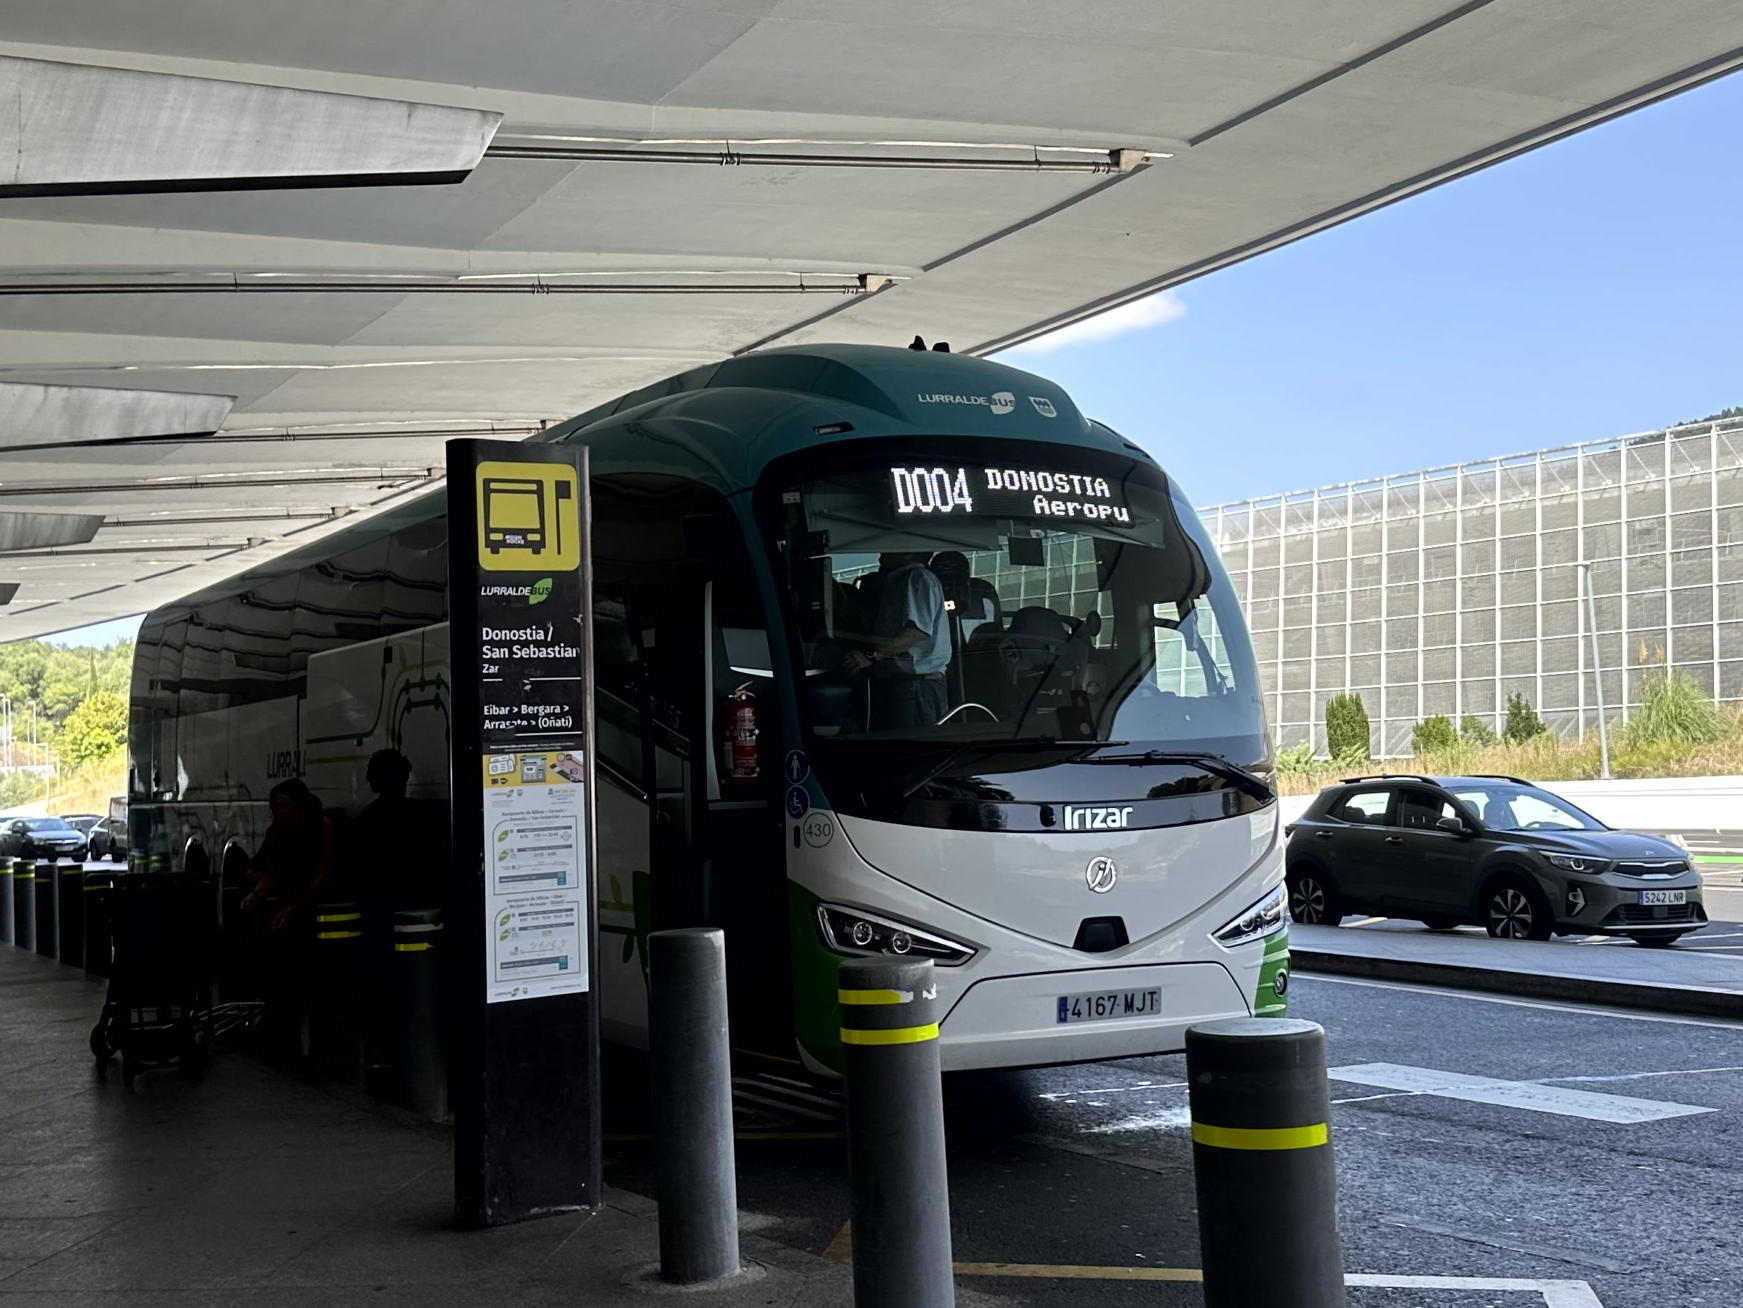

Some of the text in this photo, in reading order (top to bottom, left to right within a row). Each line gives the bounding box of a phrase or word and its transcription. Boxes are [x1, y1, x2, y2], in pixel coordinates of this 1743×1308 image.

[984, 468, 1111, 498] DONOSTIA
[1033, 495, 1130, 522] Aeropu
[482, 625, 544, 641] Donostia
[482, 645, 508, 659] San
[484, 704, 510, 715] Eibar
[521, 704, 561, 717] Bergara
[538, 716, 573, 729] (Oñati)
[1064, 805, 1133, 830] Irizar
[806, 824, 831, 838] 430
[1644, 891, 1667, 903] 5242
[1071, 995, 1118, 1018] 4167
[1124, 991, 1157, 1014] MJT
